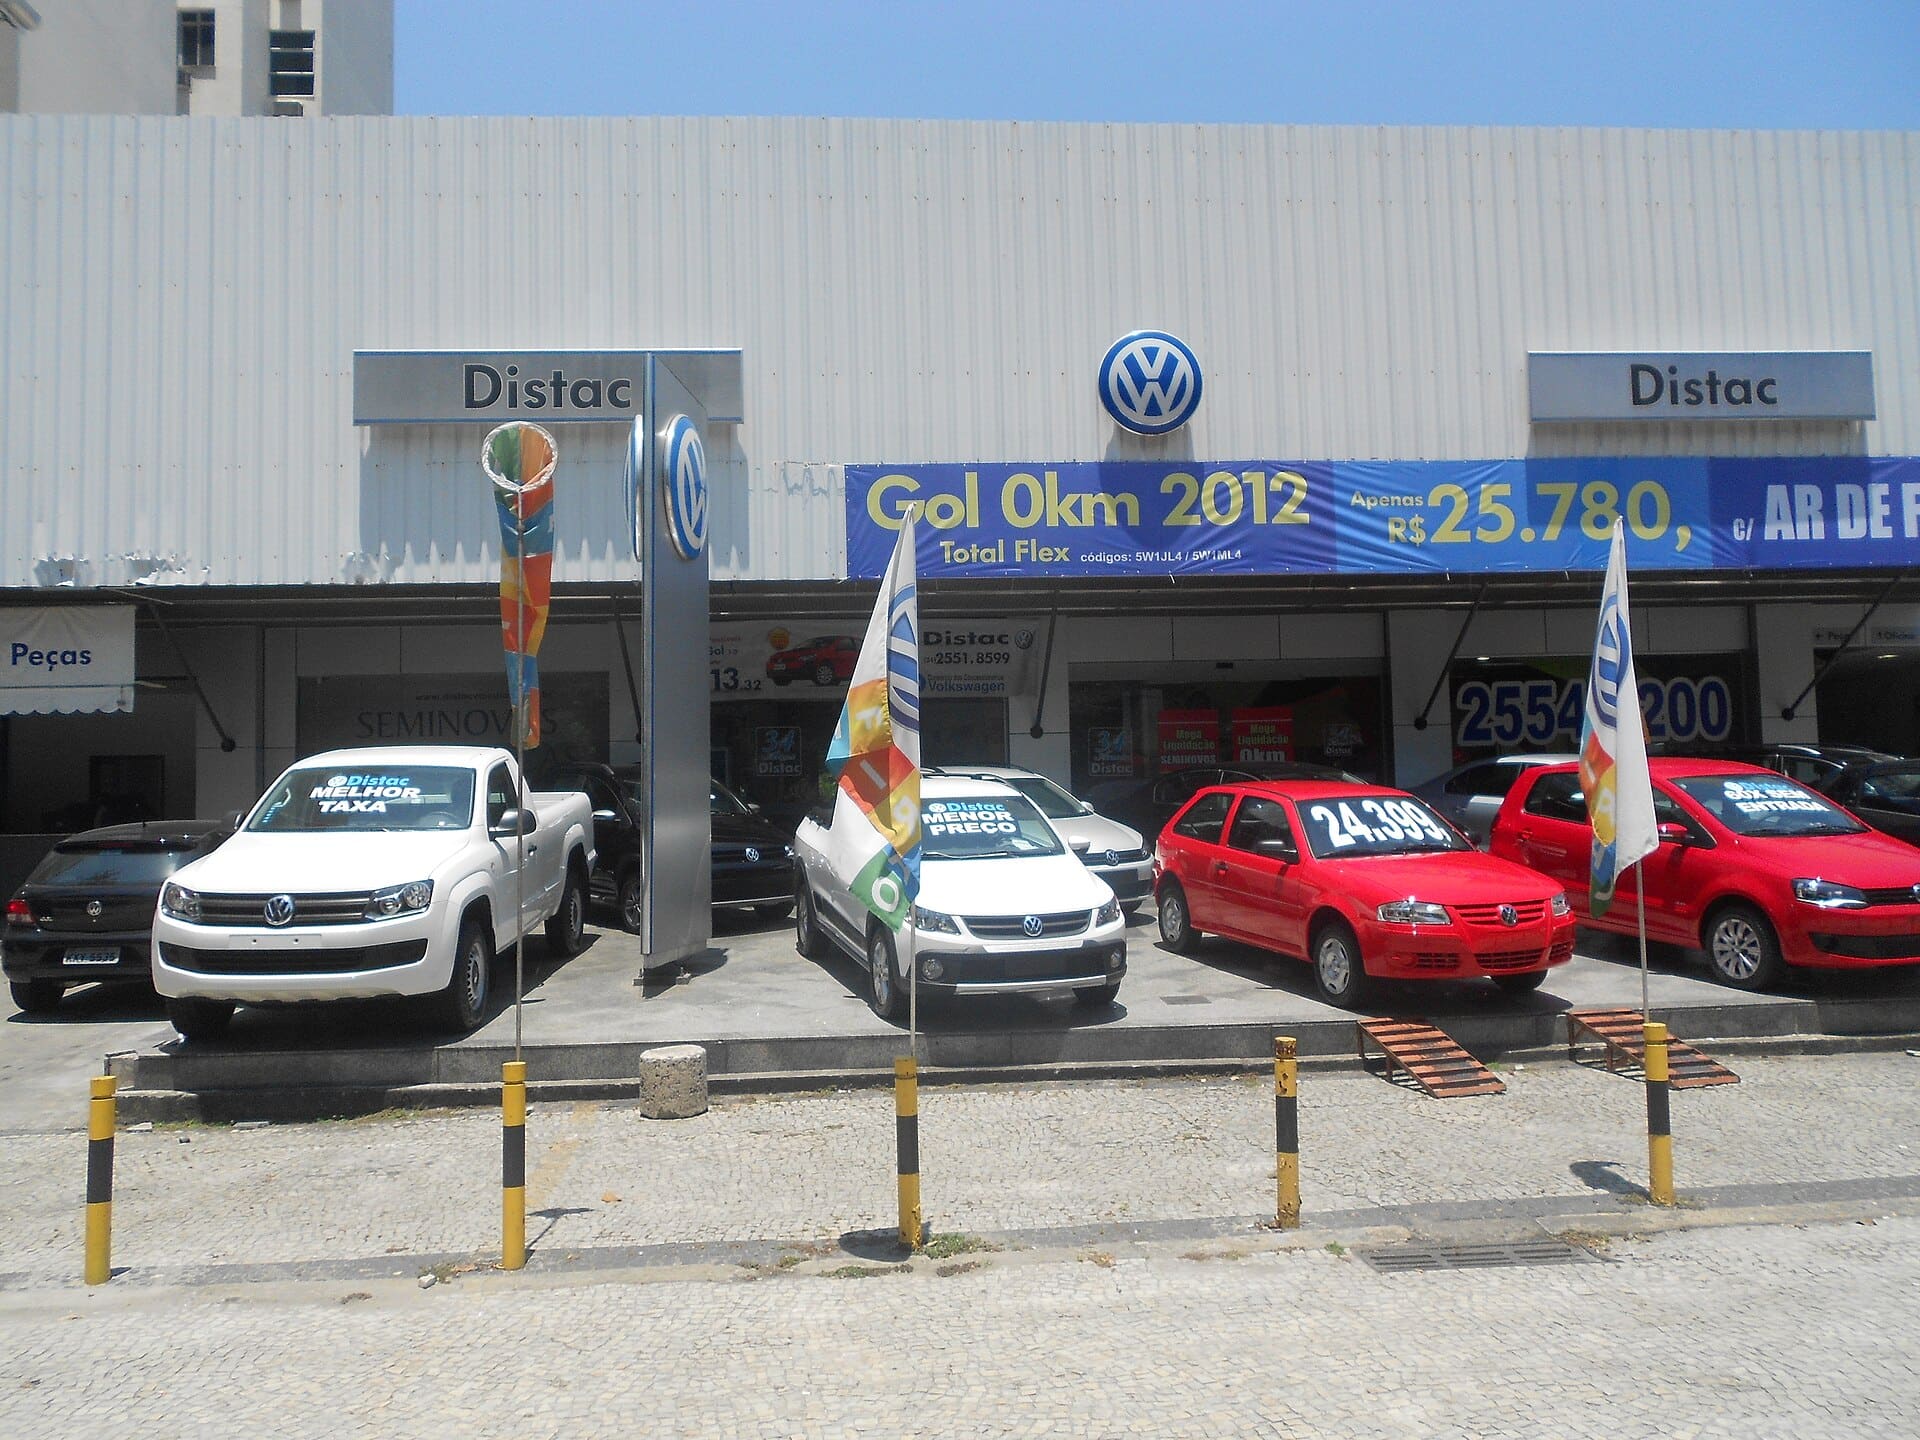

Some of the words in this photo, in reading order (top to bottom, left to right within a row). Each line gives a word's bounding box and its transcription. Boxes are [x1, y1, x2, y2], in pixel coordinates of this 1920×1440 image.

[464, 364, 632, 409] Distac
[1630, 363, 1778, 406] Distac
[866, 471, 980, 530] Gol
[1001, 471, 1140, 529] 0km
[1160, 471, 1310, 528] 2012
[1350, 491, 1423, 509] Apenas
[1388, 514, 1426, 547] R$
[1427, 480, 1692, 553] 25.780,
[1764, 484, 1825, 540] AR
[1835, 483, 1894, 539] DE
[940, 539, 1005, 564] Total
[1015, 538, 1070, 563] Flex
[1080, 552, 1132, 564] códigos:
[1136, 551, 1183, 562] 5W1JL4
[923, 630, 1009, 646] Distac
[11, 642, 92, 672] Peças
[927, 680, 1005, 694] Volkswagen
[356, 709, 557, 739] SEMINOVS
[346, 775, 410, 787] Distac
[309, 786, 421, 799] MELHOR
[318, 800, 387, 813] TAXA
[945, 802, 1006, 812] Distac
[1735, 801, 1831, 812] ENTRADA
[921, 811, 1015, 825] MENOR
[929, 822, 1017, 836] PREÇO
